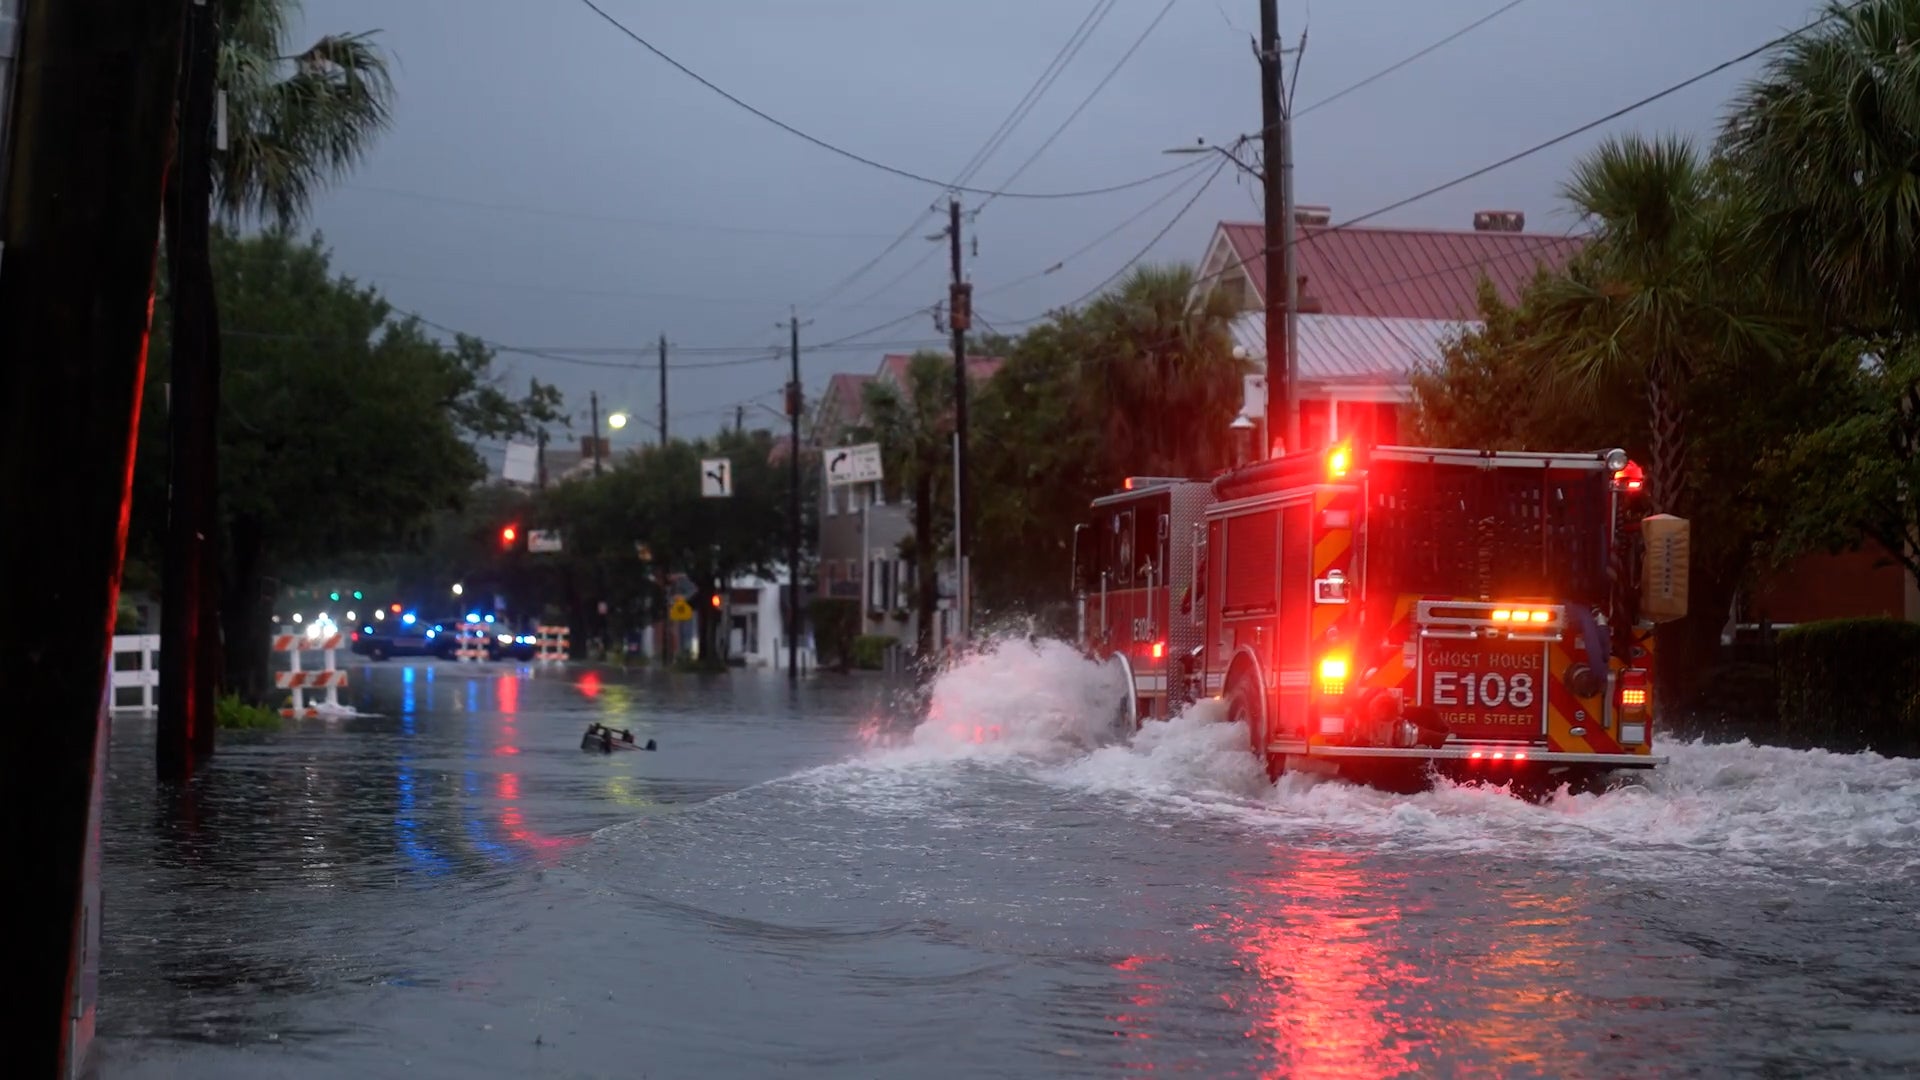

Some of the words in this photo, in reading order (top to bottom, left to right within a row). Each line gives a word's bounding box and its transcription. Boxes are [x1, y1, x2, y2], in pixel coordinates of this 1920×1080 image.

[1427, 651, 1481, 668] GHOST
[1488, 653, 1540, 669] HOUSE
[1433, 671, 1534, 708] E108
[1439, 712, 1476, 724] UGER
[1484, 713, 1534, 725] STREET
